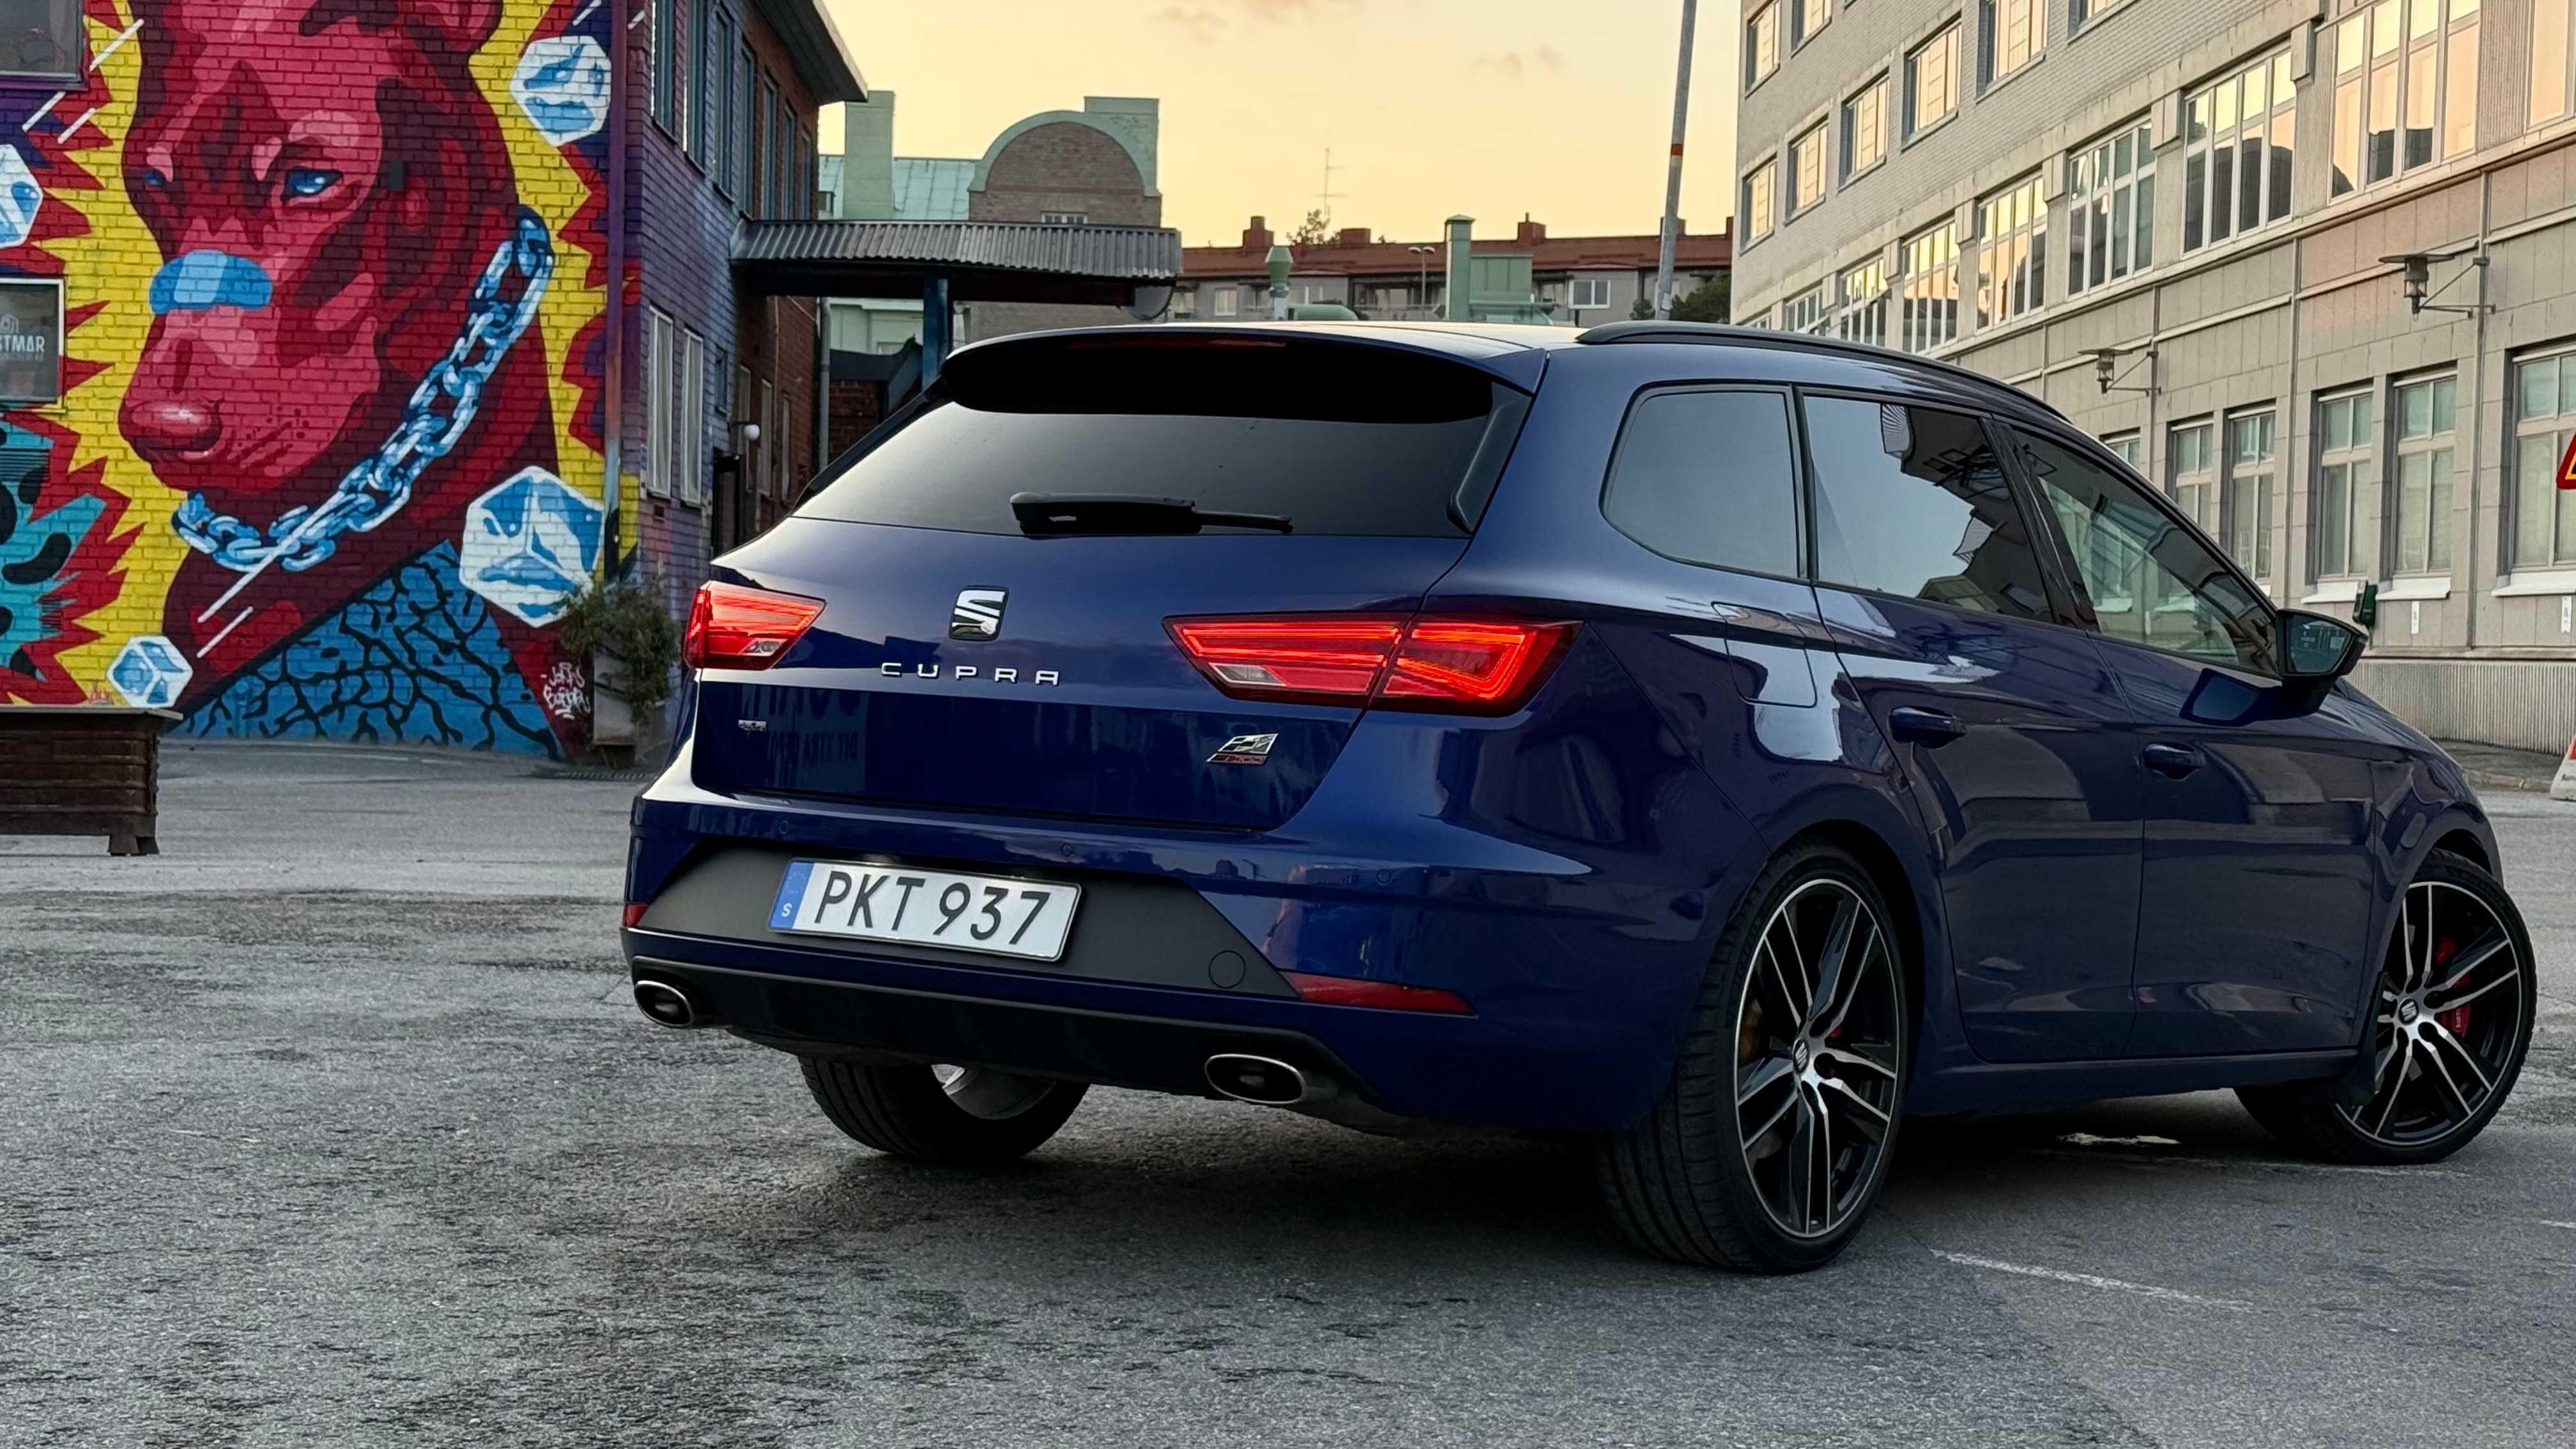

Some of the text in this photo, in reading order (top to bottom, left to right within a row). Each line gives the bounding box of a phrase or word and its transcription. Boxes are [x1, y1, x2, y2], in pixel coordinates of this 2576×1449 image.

[881, 662, 1059, 686] CUPRA
[781, 903, 793, 917] S
[815, 871, 1052, 946] PKT 937
